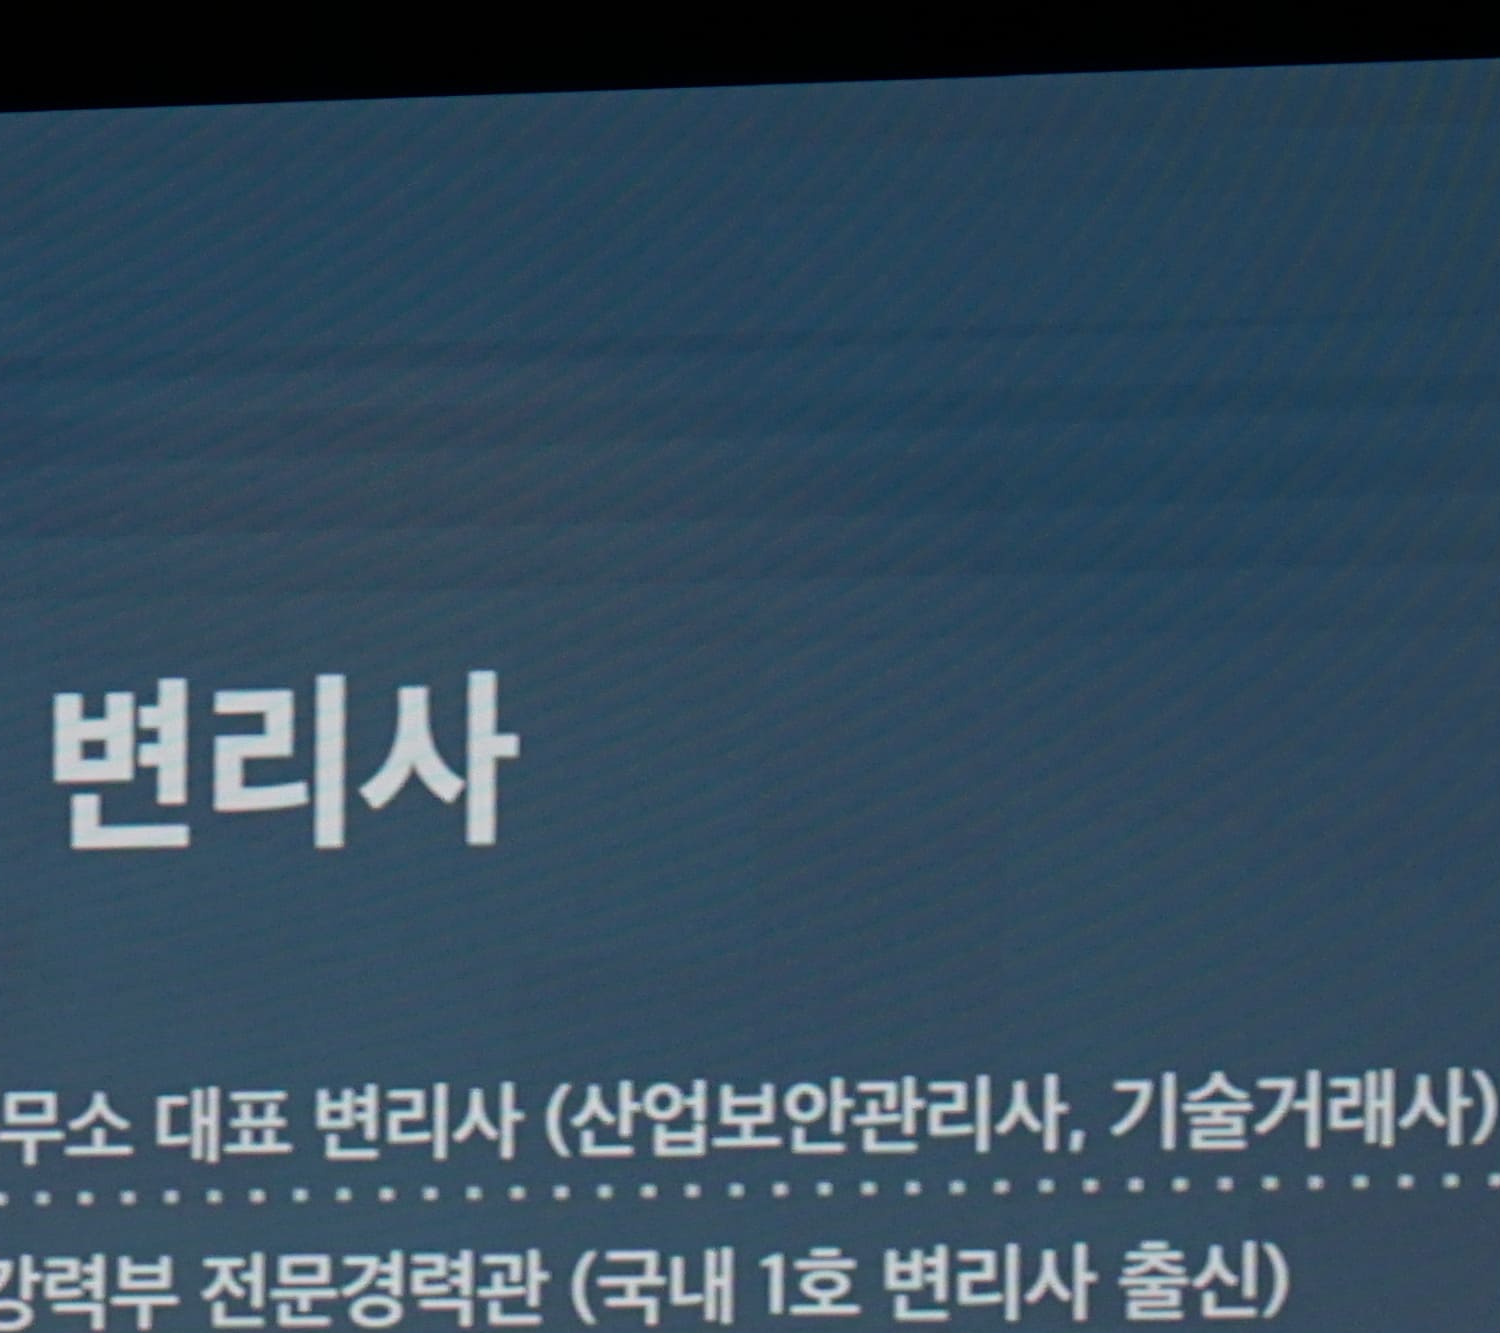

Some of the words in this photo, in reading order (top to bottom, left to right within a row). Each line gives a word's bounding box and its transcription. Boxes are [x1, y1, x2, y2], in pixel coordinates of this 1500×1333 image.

[52, 670, 521, 850] 변리사
[155, 1085, 294, 1164] 대표
[315, 1080, 526, 1161] 변리사
[545, 1072, 1086, 1158] (산업보안관리사,
[1110, 1066, 1500, 1151] 기술거래사)
[200, 1247, 551, 1329] 전문경력관
[570, 1245, 735, 1327] (국내
[760, 1246, 862, 1316] 1호
[883, 1241, 1099, 1323] 변리사
[1117, 1239, 1290, 1321] 출신)
